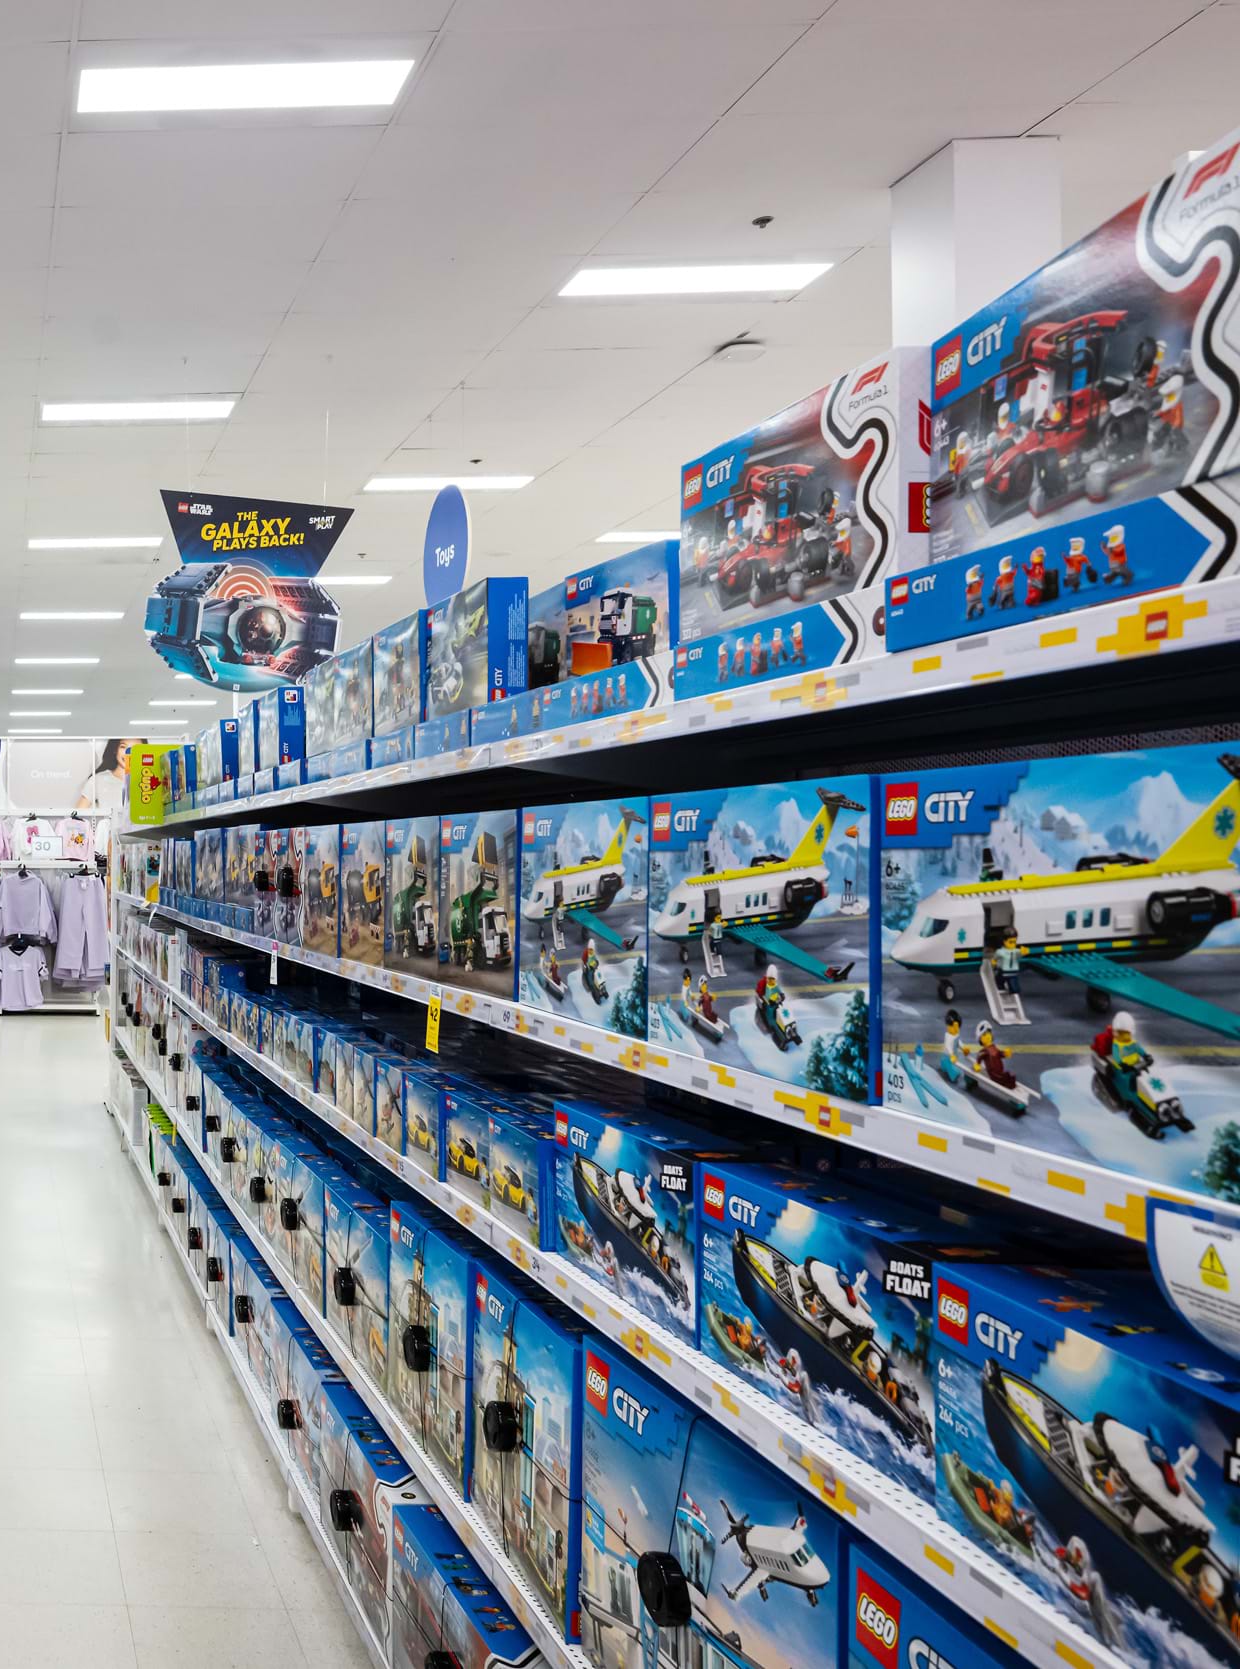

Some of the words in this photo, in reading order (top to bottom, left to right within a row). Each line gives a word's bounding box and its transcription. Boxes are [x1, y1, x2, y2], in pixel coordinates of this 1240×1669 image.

[936, 350, 961, 386] LEGO
[966, 317, 1008, 367] CITY
[848, 389, 882, 412] Formula
[683, 477, 702, 498] LEGO
[705, 455, 736, 488] CITY
[189, 508, 213, 516] WARS
[236, 511, 259, 521] THE
[308, 515, 337, 525] SMART
[200, 517, 292, 542] GALAXY
[316, 522, 334, 531] PLAY
[212, 536, 258, 552] PLAYS
[260, 533, 305, 548] BACK!
[434, 543, 456, 568] Toys
[578, 575, 594, 591] CITY
[911, 574, 937, 595] CITY
[688, 647, 703, 661] CITY
[494, 667, 503, 686] CITY
[30, 769, 44, 780] On
[139, 766, 154, 804] duplo
[886, 797, 916, 820] LEGO
[924, 790, 975, 824] CITY
[536, 819, 553, 837] CITY
[653, 813, 671, 830] LEGO
[673, 809, 701, 832] CITY
[452, 825, 468, 841] CITY
[34, 841, 51, 852] 30
[885, 859, 902, 878] 6+
[429, 1006, 438, 1022] 42
[502, 1010, 511, 1022] 69
[887, 1072, 905, 1090] 403
[887, 1091, 902, 1105] pcs
[555, 1121, 568, 1138] LEGO
[569, 1128, 590, 1150] CITY
[663, 1164, 684, 1178] BOATS
[660, 1174, 688, 1192] FLOAT
[330, 1205, 339, 1219] CITY
[704, 1185, 725, 1208] LEGO
[728, 1195, 761, 1228] CITY
[400, 1229, 415, 1249] CITY
[703, 1233, 714, 1248] 6+
[1192, 1225, 1233, 1242] WARNING
[889, 1260, 925, 1279] BOATS
[714, 1275, 725, 1291] pcs
[885, 1275, 932, 1300] FLOAT
[488, 1295, 506, 1321] CITY
[938, 1294, 968, 1327] LEGO
[974, 1311, 1024, 1360] CITY
[937, 1357, 954, 1379] 6+
[587, 1369, 607, 1398] LEGO
[612, 1385, 649, 1436] CITY
[326, 1413, 335, 1429] CITY
[938, 1404, 954, 1429] 264
[954, 1421, 969, 1439] pcs
[404, 1545, 419, 1571] CITY
[858, 1592, 897, 1648] LEGO
